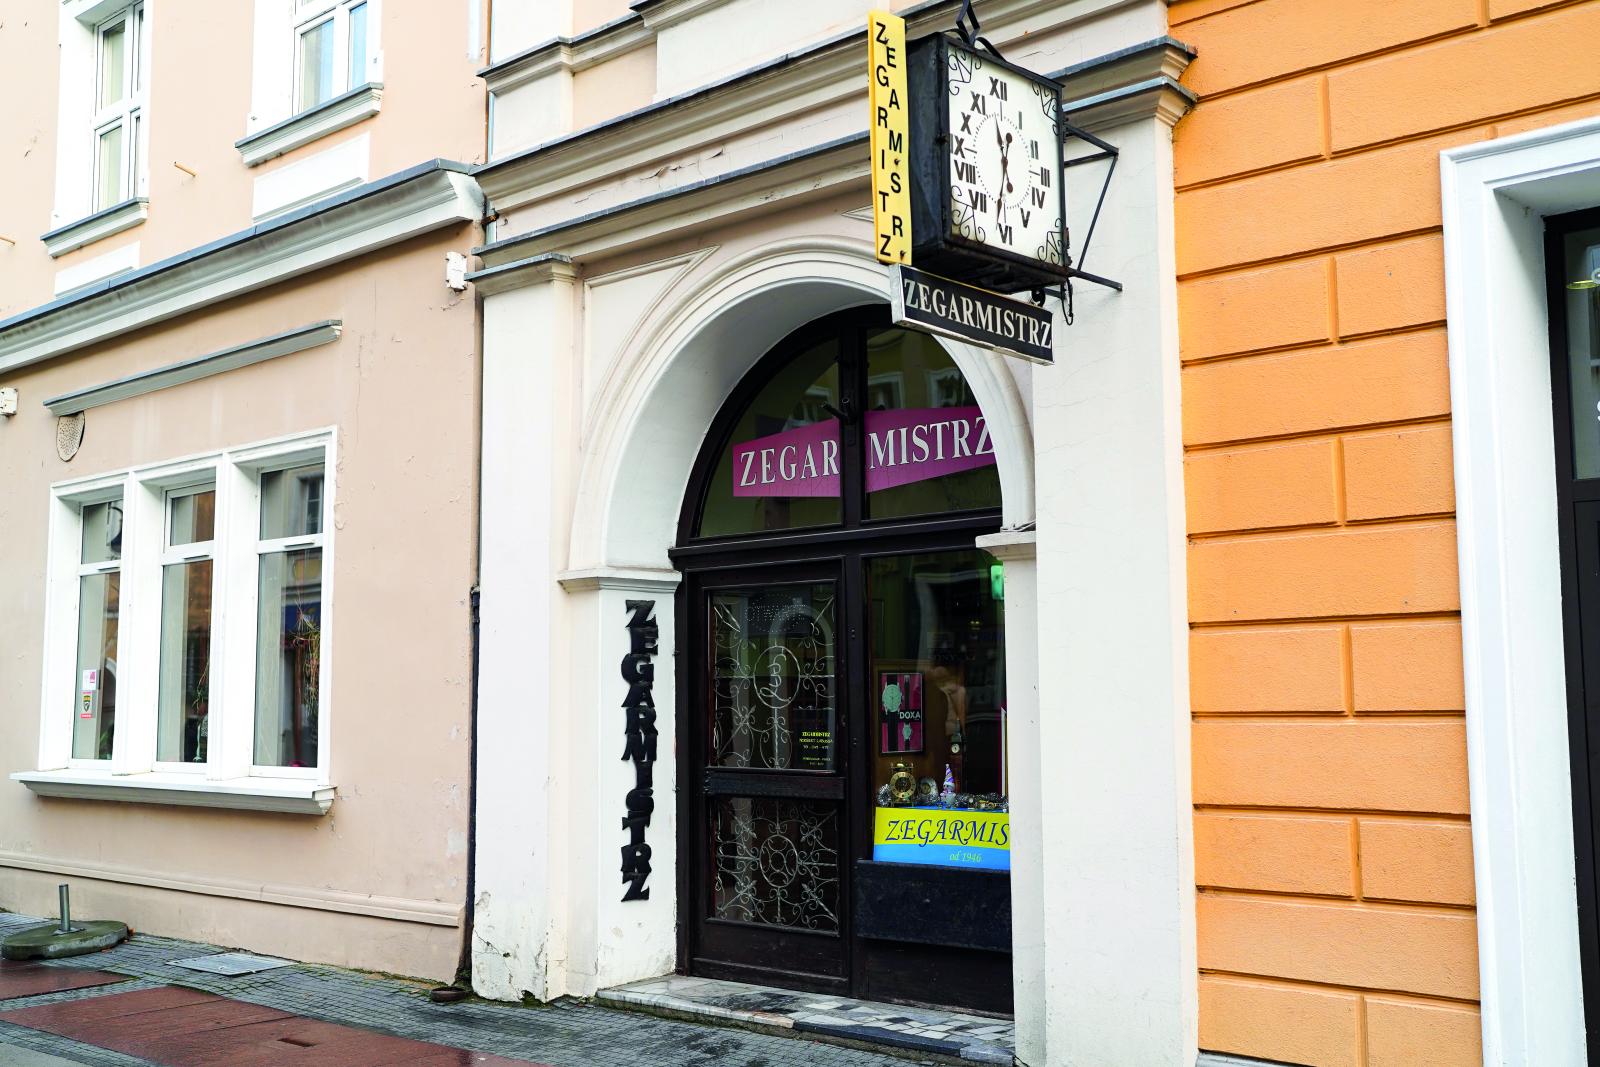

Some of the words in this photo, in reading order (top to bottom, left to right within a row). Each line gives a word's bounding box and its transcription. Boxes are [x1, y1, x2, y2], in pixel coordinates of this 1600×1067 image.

[989, 76, 1008, 101] XII
[970, 91, 986, 115] XI
[960, 112, 971, 135] X
[875, 22, 903, 257] ZEGARMISTRZ
[950, 133, 965, 159] IX
[1030, 139, 1039, 160] II
[954, 159, 976, 185] VIII
[1040, 166, 1050, 188] III
[968, 189, 987, 213] VII
[1031, 187, 1046, 209] IV
[1020, 208, 1030, 228] V
[998, 222, 1013, 246] VI
[904, 278, 1052, 350] ZEGARMISTRZ
[899, 711, 921, 719] DOXA
[621, 599, 659, 903] ZEGARMISTRZ
[885, 818, 1009, 848] ZEGARMIS
